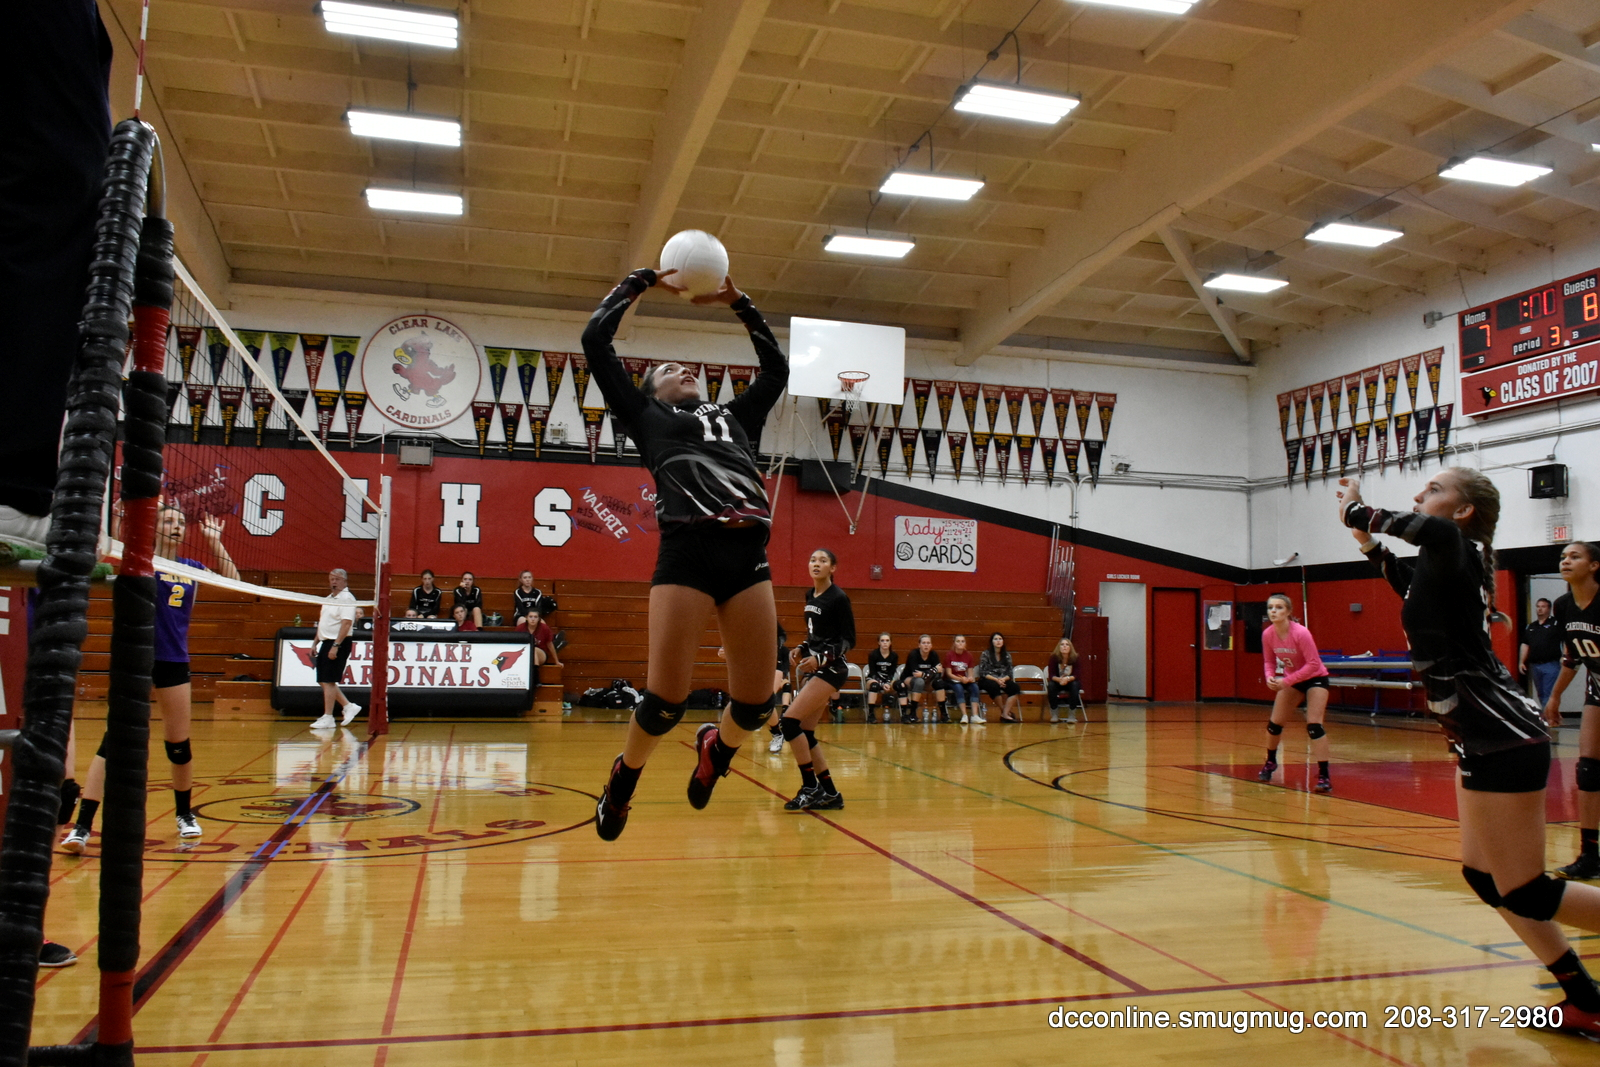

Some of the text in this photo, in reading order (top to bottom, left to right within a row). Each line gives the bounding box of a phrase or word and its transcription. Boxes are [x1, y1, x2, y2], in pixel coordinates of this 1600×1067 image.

[1564, 278, 1596, 296] Guests
[1584, 292, 1598, 322] 8
[1464, 312, 1486, 326] Home
[389, 319, 464, 342] CLEAR LAKE
[1479, 324, 1490, 348] 7
[1550, 326, 1560, 346] 3
[1572, 331, 1579, 339] B
[1514, 337, 1541, 356] period
[1518, 352, 1577, 375] DONATED BY THE
[1500, 360, 1598, 404] CLASS OF 2007
[386, 405, 452, 424] CARDINALS
[698, 414, 734, 442] 11
[577, 507, 594, 518] #15
[583, 489, 628, 538] VALERIE
[904, 518, 945, 545] lady
[1554, 527, 1567, 540] EXIT
[918, 545, 974, 566] CARDS
[168, 584, 185, 607] 2
[808, 617, 814, 634] 4
[1565, 621, 1600, 634] CARDINALS
[416, 643, 472, 662] LAKE
[1572, 638, 1600, 658] 10
[340, 664, 490, 686] ARDINALS
